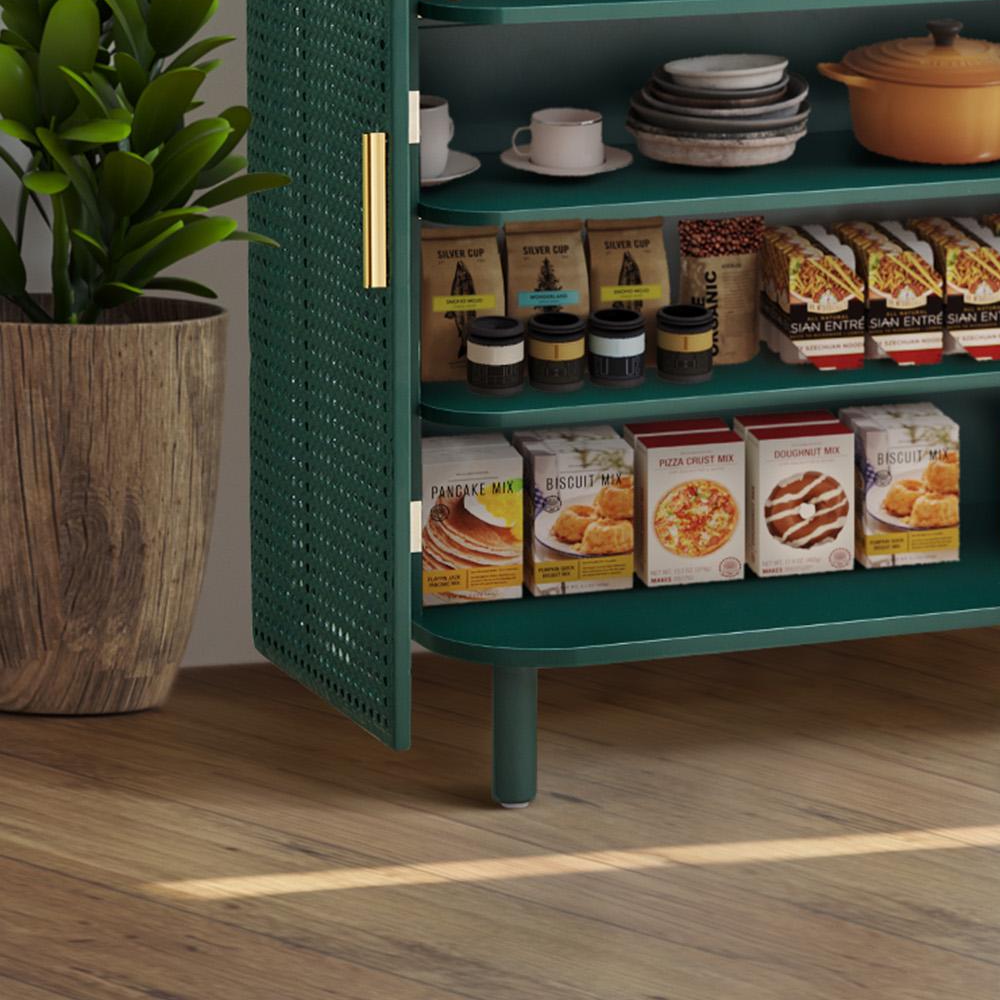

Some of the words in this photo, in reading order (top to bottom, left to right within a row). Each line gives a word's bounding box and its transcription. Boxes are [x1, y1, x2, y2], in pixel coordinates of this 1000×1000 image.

[522, 246, 550, 256] SILVER
[552, 245, 570, 254] CUP
[604, 240, 631, 250] SILVER
[633, 239, 650, 249] CUP
[437, 250, 465, 259] SILVER
[467, 248, 484, 258] CUP
[790, 322, 821, 334] SIAN
[824, 316, 865, 332] ENTRÉ
[869, 317, 900, 329] SIAN
[903, 311, 943, 327] ENTRÉ
[947, 312, 977, 325] SIAN
[774, 448, 821, 459] DOUGHNUT
[824, 446, 840, 456] MIX
[877, 450, 922, 466] BISCUIT
[929, 449, 949, 461] MIX
[659, 458, 684, 468] PIZZA
[686, 456, 714, 466] CRUST
[717, 454, 734, 464] MIX
[546, 474, 594, 491] BISCUIT
[601, 472, 622, 487] MIX
[431, 482, 486, 499] PANCAKE
[492, 480, 514, 494] MIX
